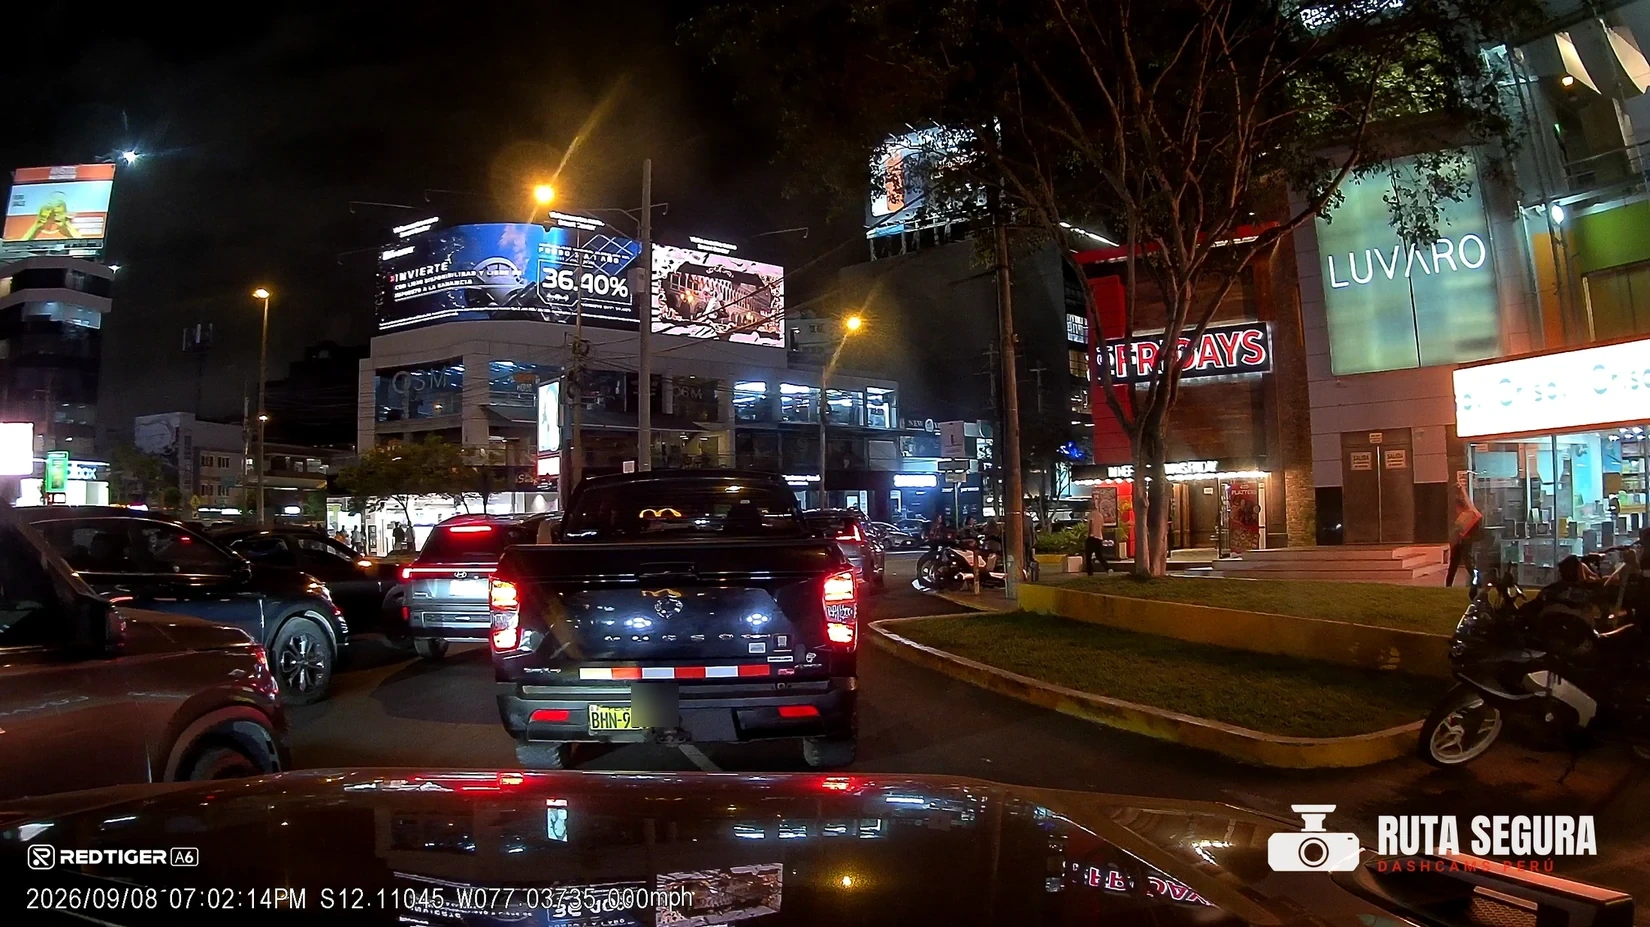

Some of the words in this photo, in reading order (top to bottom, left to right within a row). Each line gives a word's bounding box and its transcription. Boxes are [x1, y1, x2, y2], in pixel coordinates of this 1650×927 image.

[394, 261, 449, 283] INVIERTE
[1327, 234, 1486, 289] LUVARO
[541, 267, 629, 298] 36.40%
[1114, 329, 1266, 379] FRDAYS
